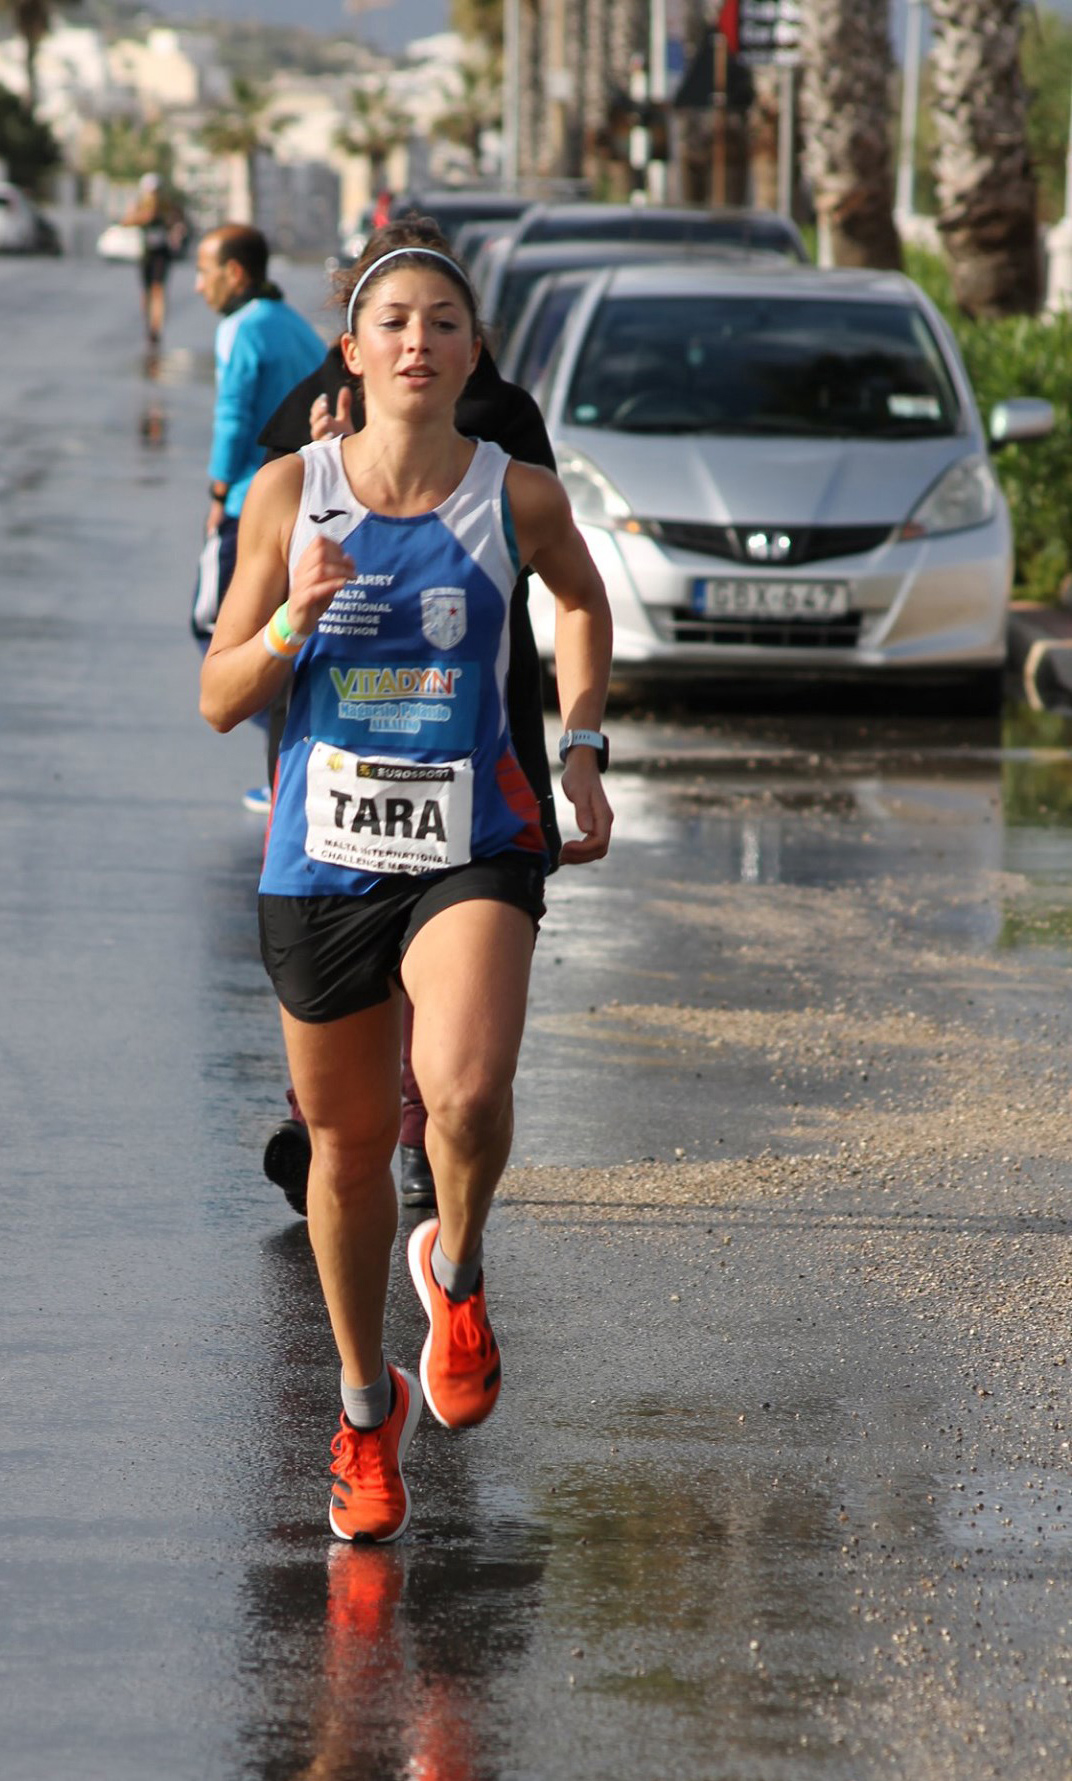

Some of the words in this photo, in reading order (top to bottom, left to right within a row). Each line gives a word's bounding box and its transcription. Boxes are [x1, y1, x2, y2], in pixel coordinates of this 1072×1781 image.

[318, 623, 378, 636] MARATHON
[377, 767, 449, 779] EUROSPORT
[330, 789, 447, 842] TARA
[321, 849, 385, 869] CHALLENGE
[324, 839, 358, 853] MALTA
[361, 846, 451, 865] INTERNATIONAL
